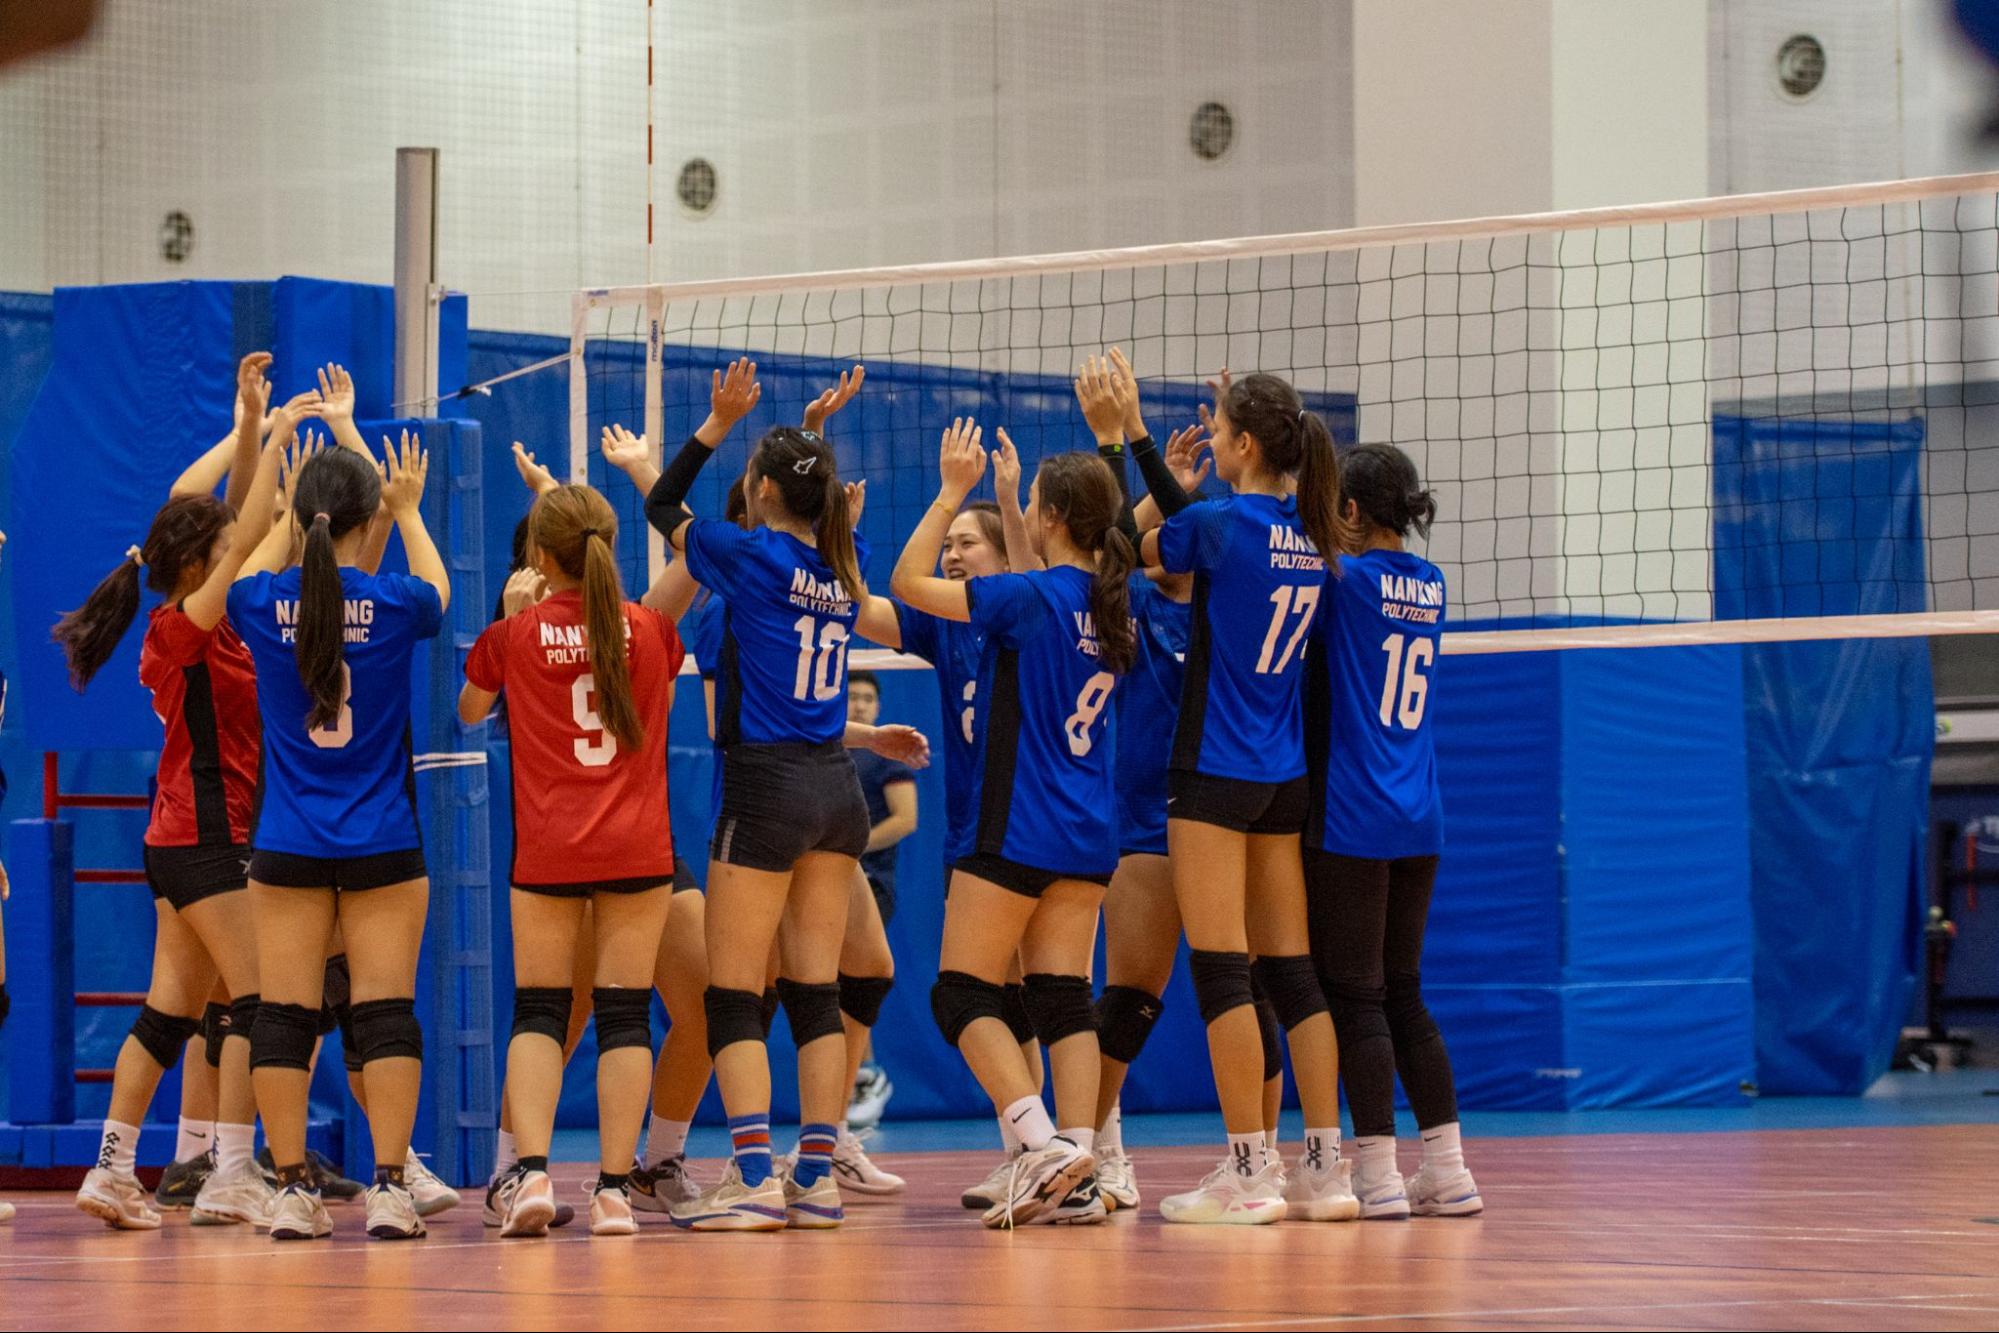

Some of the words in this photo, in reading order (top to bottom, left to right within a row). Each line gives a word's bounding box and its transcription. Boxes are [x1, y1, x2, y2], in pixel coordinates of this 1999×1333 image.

[275, 599, 374, 625] NANG
[1255, 584, 1321, 675] 17
[794, 615, 850, 701] 10
[1379, 633, 1434, 730] 16
[1064, 671, 1115, 757] 8
